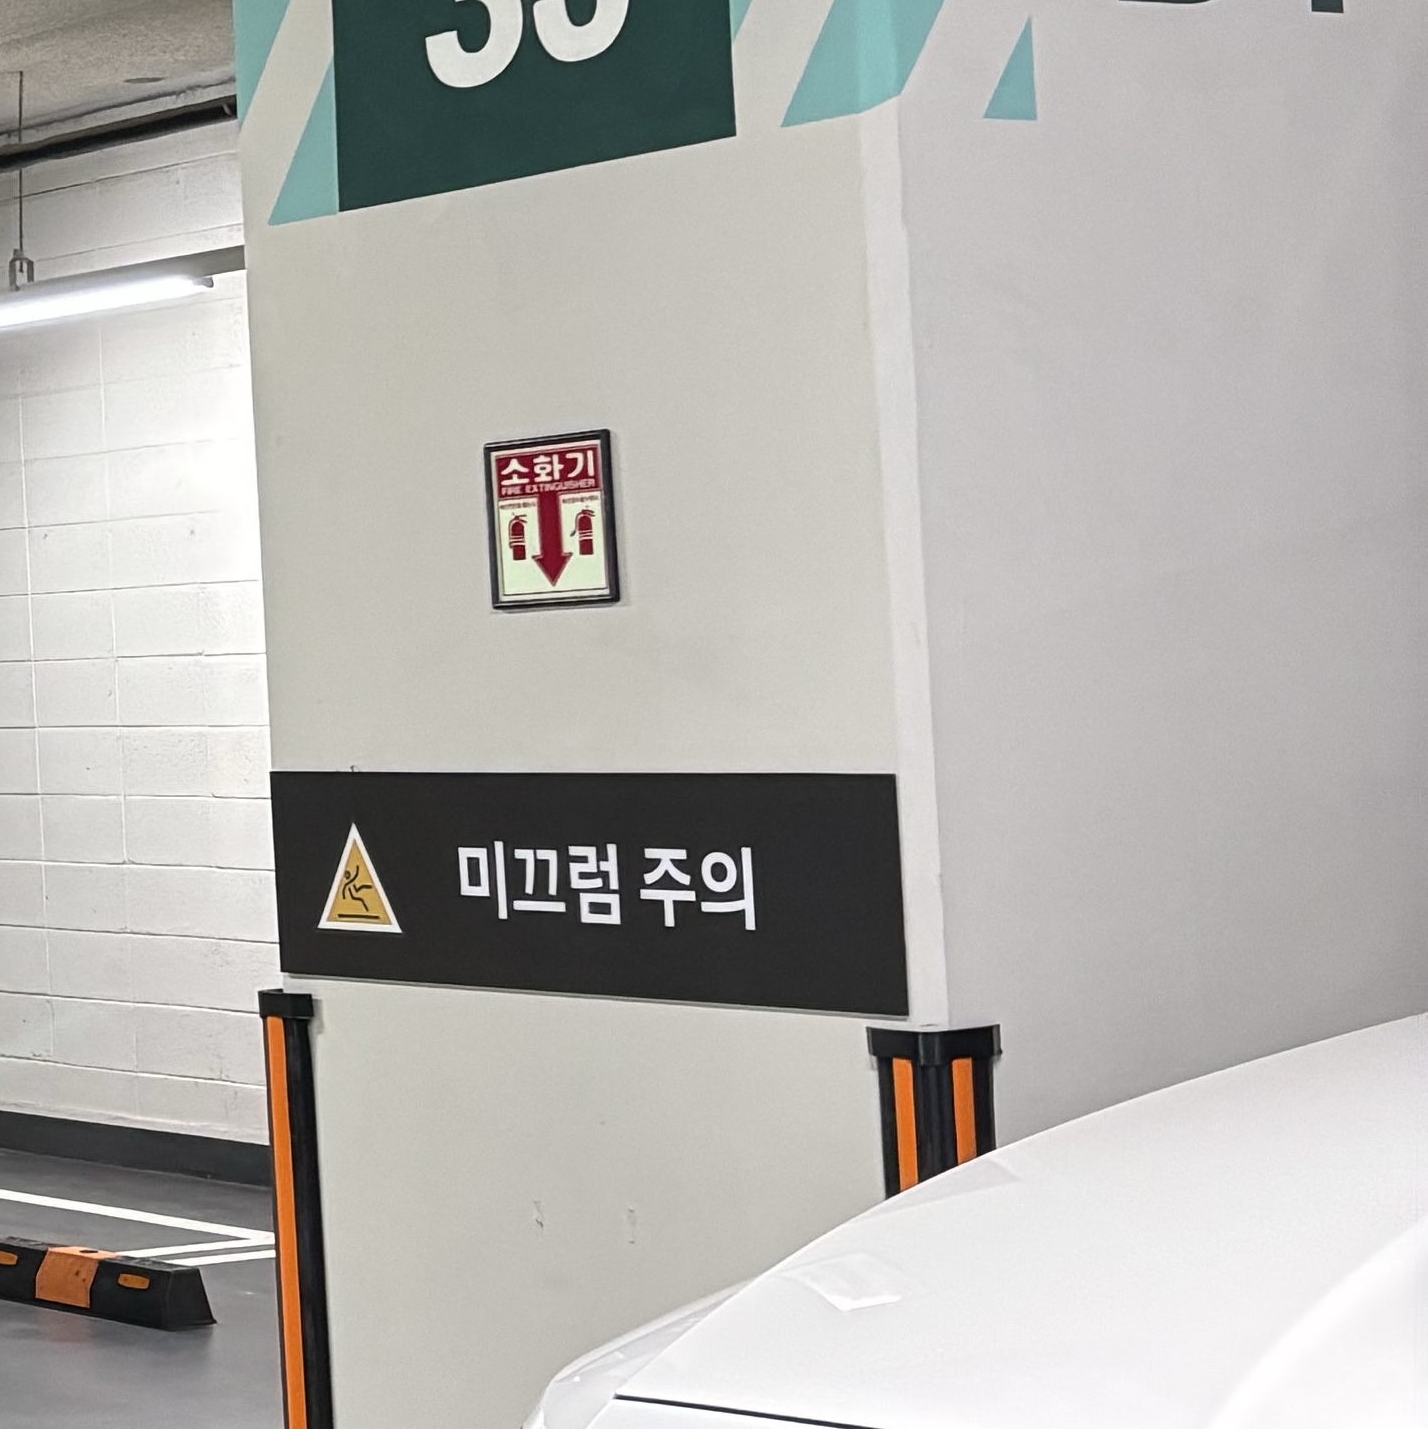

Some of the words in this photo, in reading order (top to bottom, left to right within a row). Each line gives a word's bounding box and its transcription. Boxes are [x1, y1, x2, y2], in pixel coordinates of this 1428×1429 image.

[500, 450, 595, 486] 소화기
[501, 485, 523, 496] FIRE
[525, 478, 596, 494] EXTINGUISHER
[457, 840, 621, 925] 미끄럼
[639, 846, 756, 931] 주의
